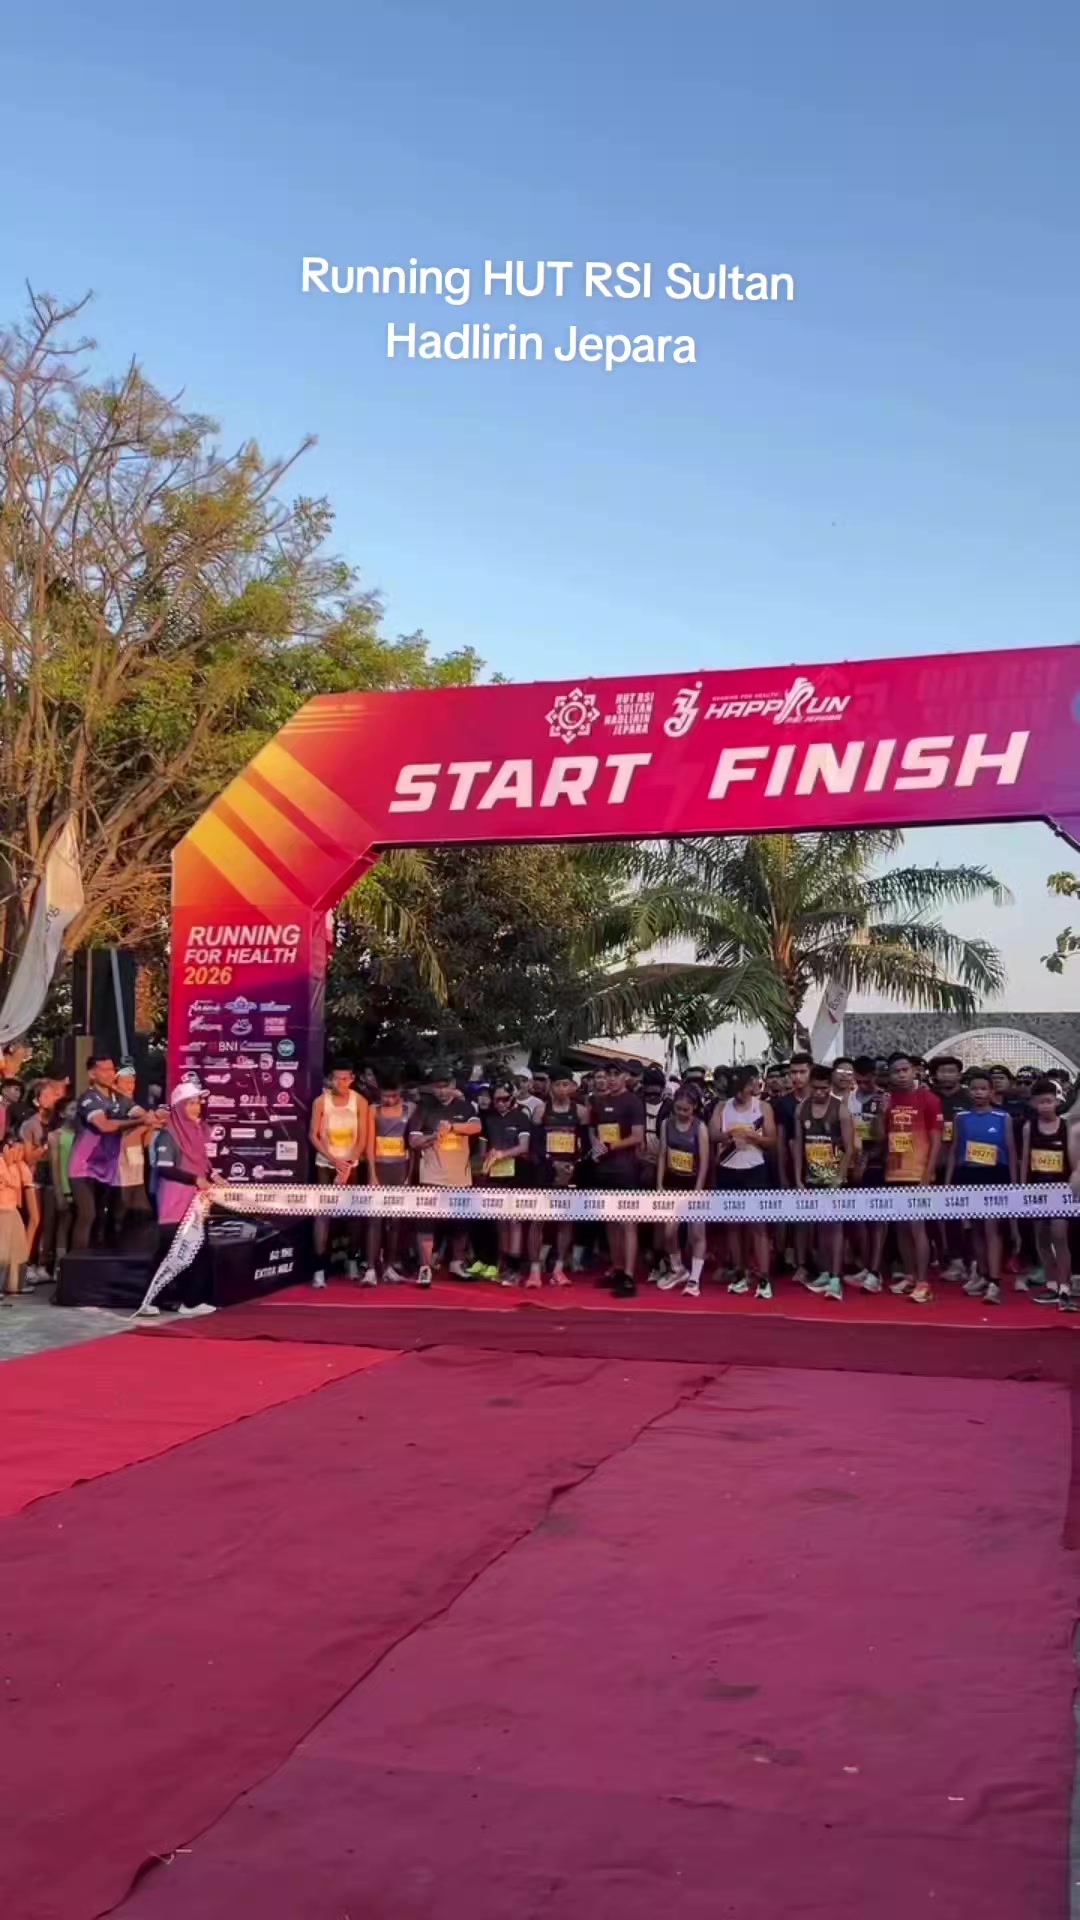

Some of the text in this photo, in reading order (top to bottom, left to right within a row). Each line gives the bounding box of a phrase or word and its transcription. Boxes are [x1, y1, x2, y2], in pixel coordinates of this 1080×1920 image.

[616, 702, 654, 715] SULTAN
[612, 723, 649, 736] JEPARA
[388, 730, 1031, 813] START FINISH
[187, 924, 301, 946] RUNNING
[183, 947, 297, 964] FOR HEALTH
[183, 966, 233, 985] 2026
[218, 1041, 238, 1052] BNI
